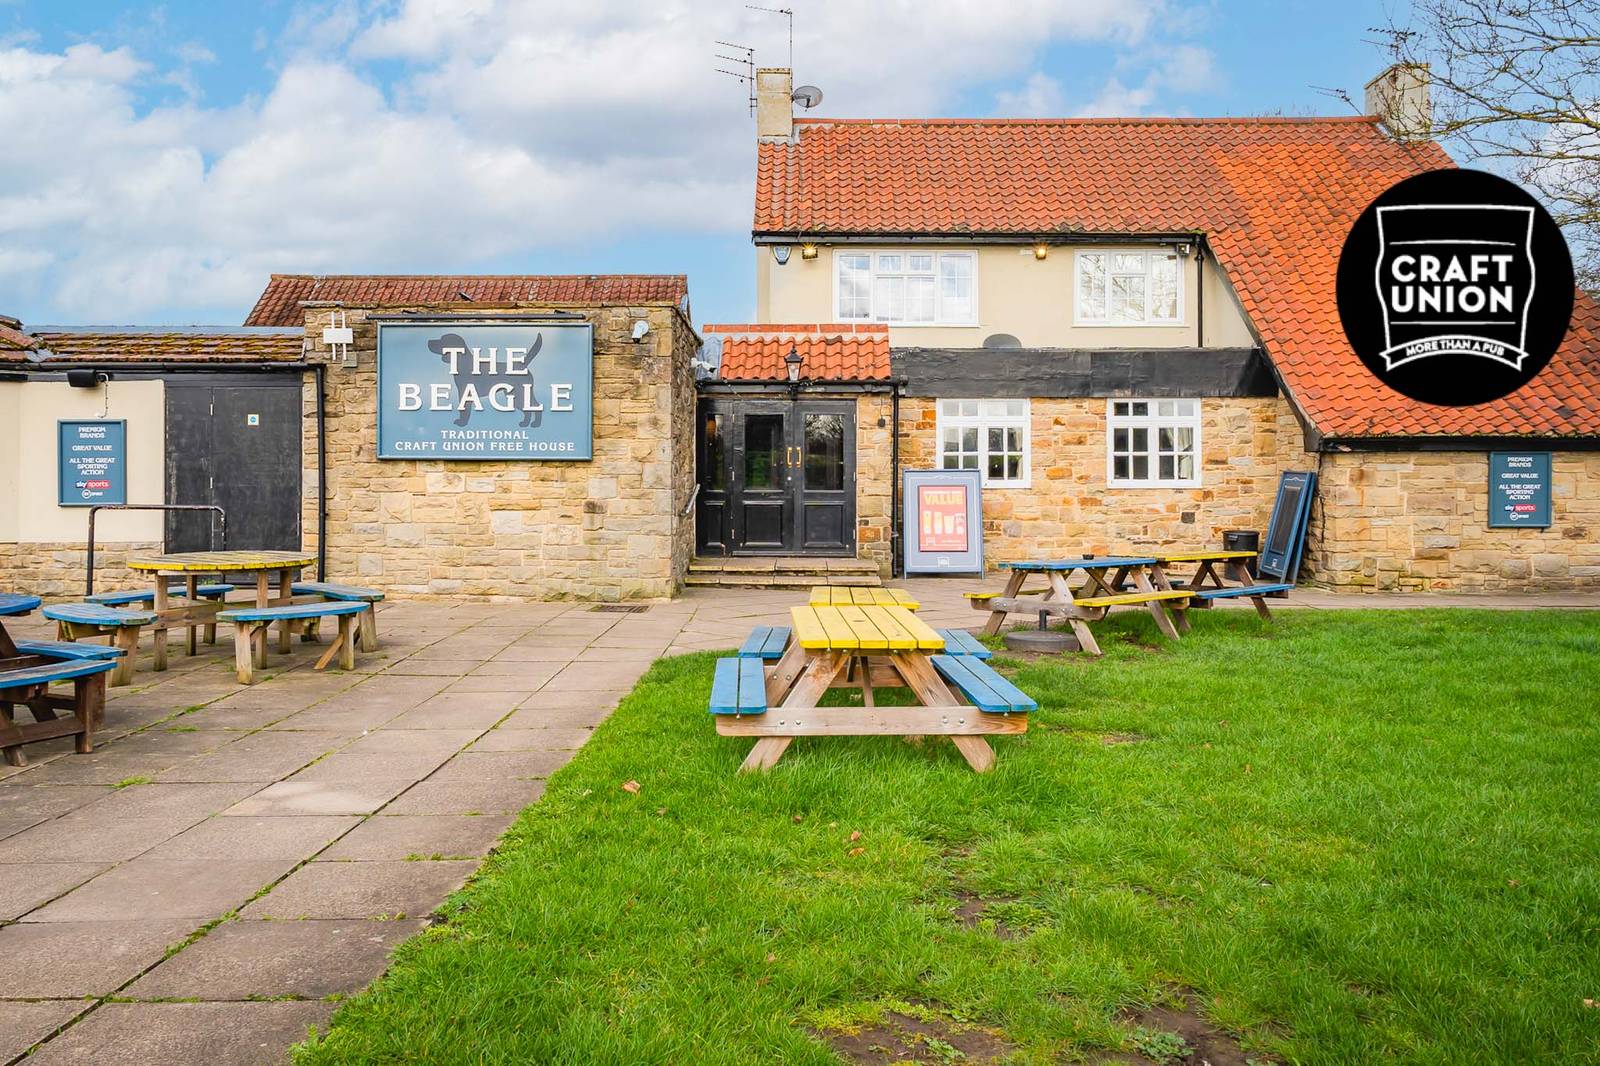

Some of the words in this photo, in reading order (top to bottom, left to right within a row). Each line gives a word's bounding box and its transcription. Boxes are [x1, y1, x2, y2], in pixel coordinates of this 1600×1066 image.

[442, 347, 528, 375] THE
[398, 383, 574, 411] BEAGLE
[440, 430, 529, 440] TRADITIONAL
[395, 441, 437, 451] CRAFT
[443, 441, 484, 451] UNION
[490, 442, 524, 451] FREE
[529, 442, 575, 451] HOUSE
[76, 480, 87, 489] sky
[925, 494, 963, 504] VALUE
[1504, 504, 1515, 512] sky
